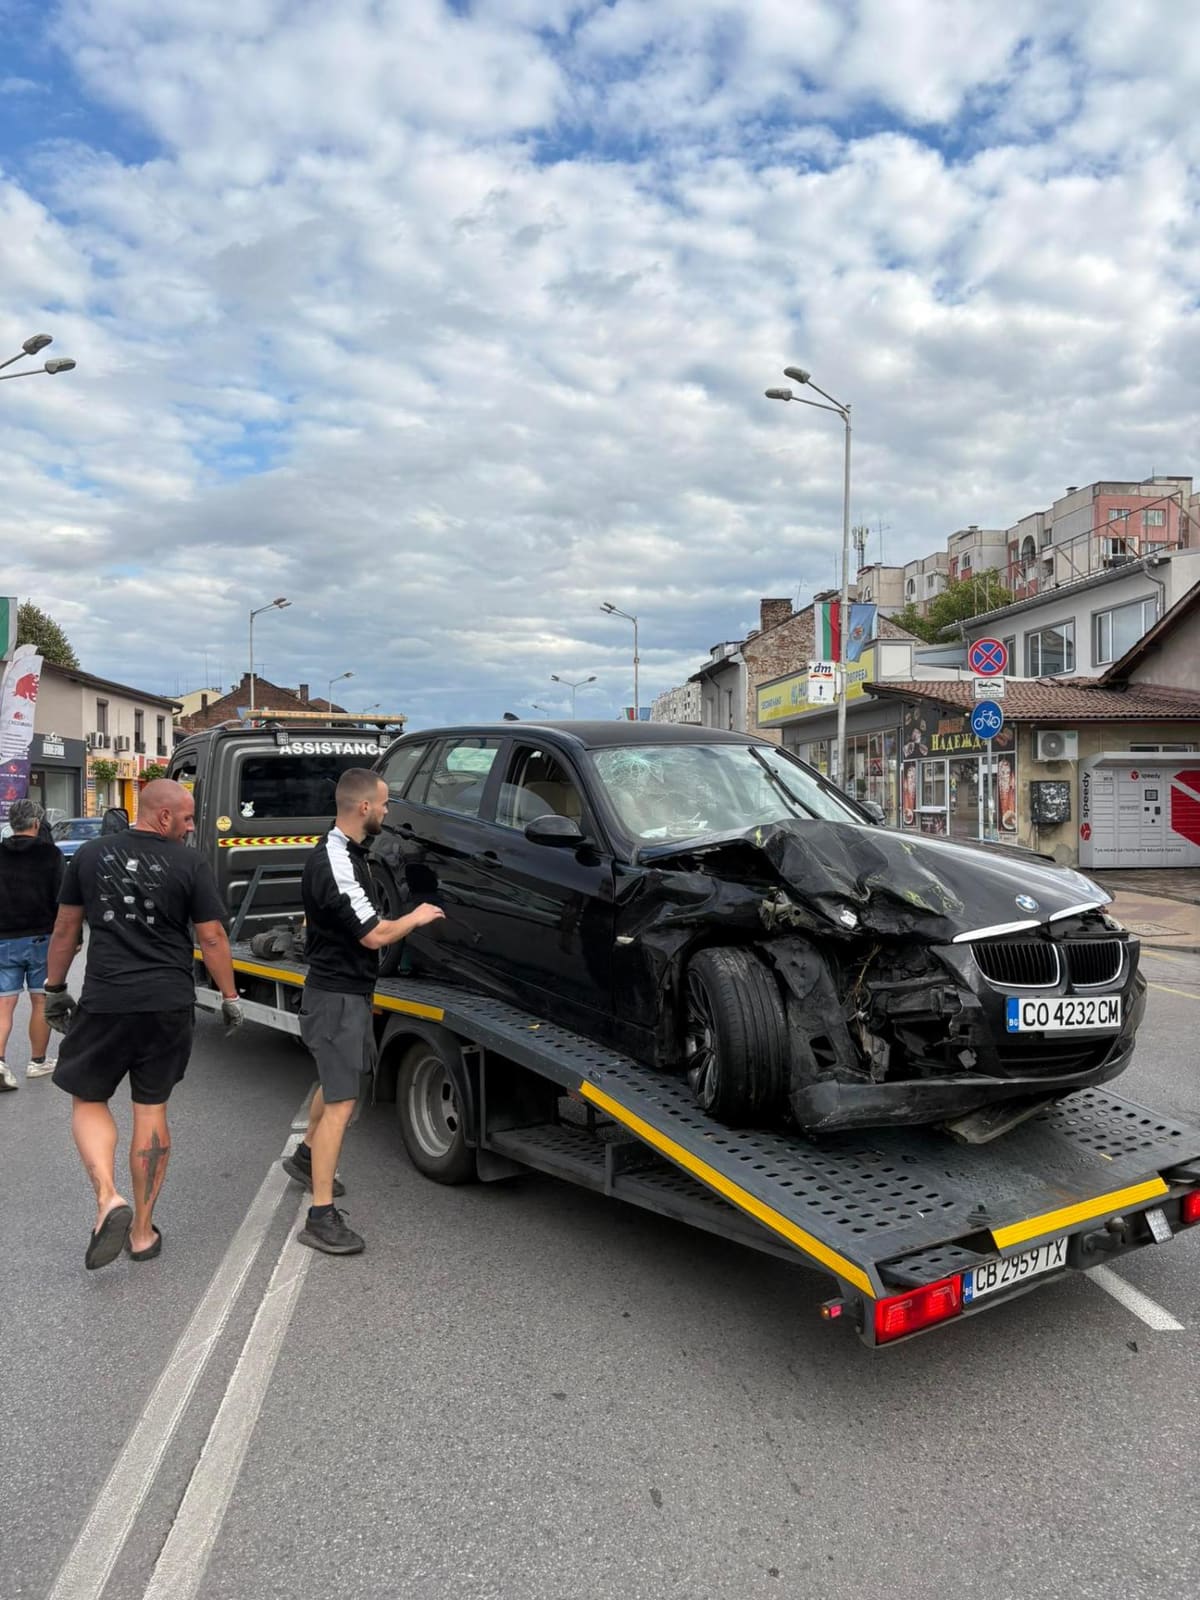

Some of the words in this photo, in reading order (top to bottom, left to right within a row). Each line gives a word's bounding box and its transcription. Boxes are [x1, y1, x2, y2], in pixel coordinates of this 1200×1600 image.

[813, 662, 832, 674] dm
[1082, 772, 1091, 819] speedy
[1023, 1002, 1049, 1027] CO
[1053, 1001, 1095, 1026] 4232
[1098, 999, 1119, 1024] CM
[976, 1262, 997, 1292] CB
[1001, 1248, 1040, 1283] 2959
[1045, 1238, 1065, 1267] TX
